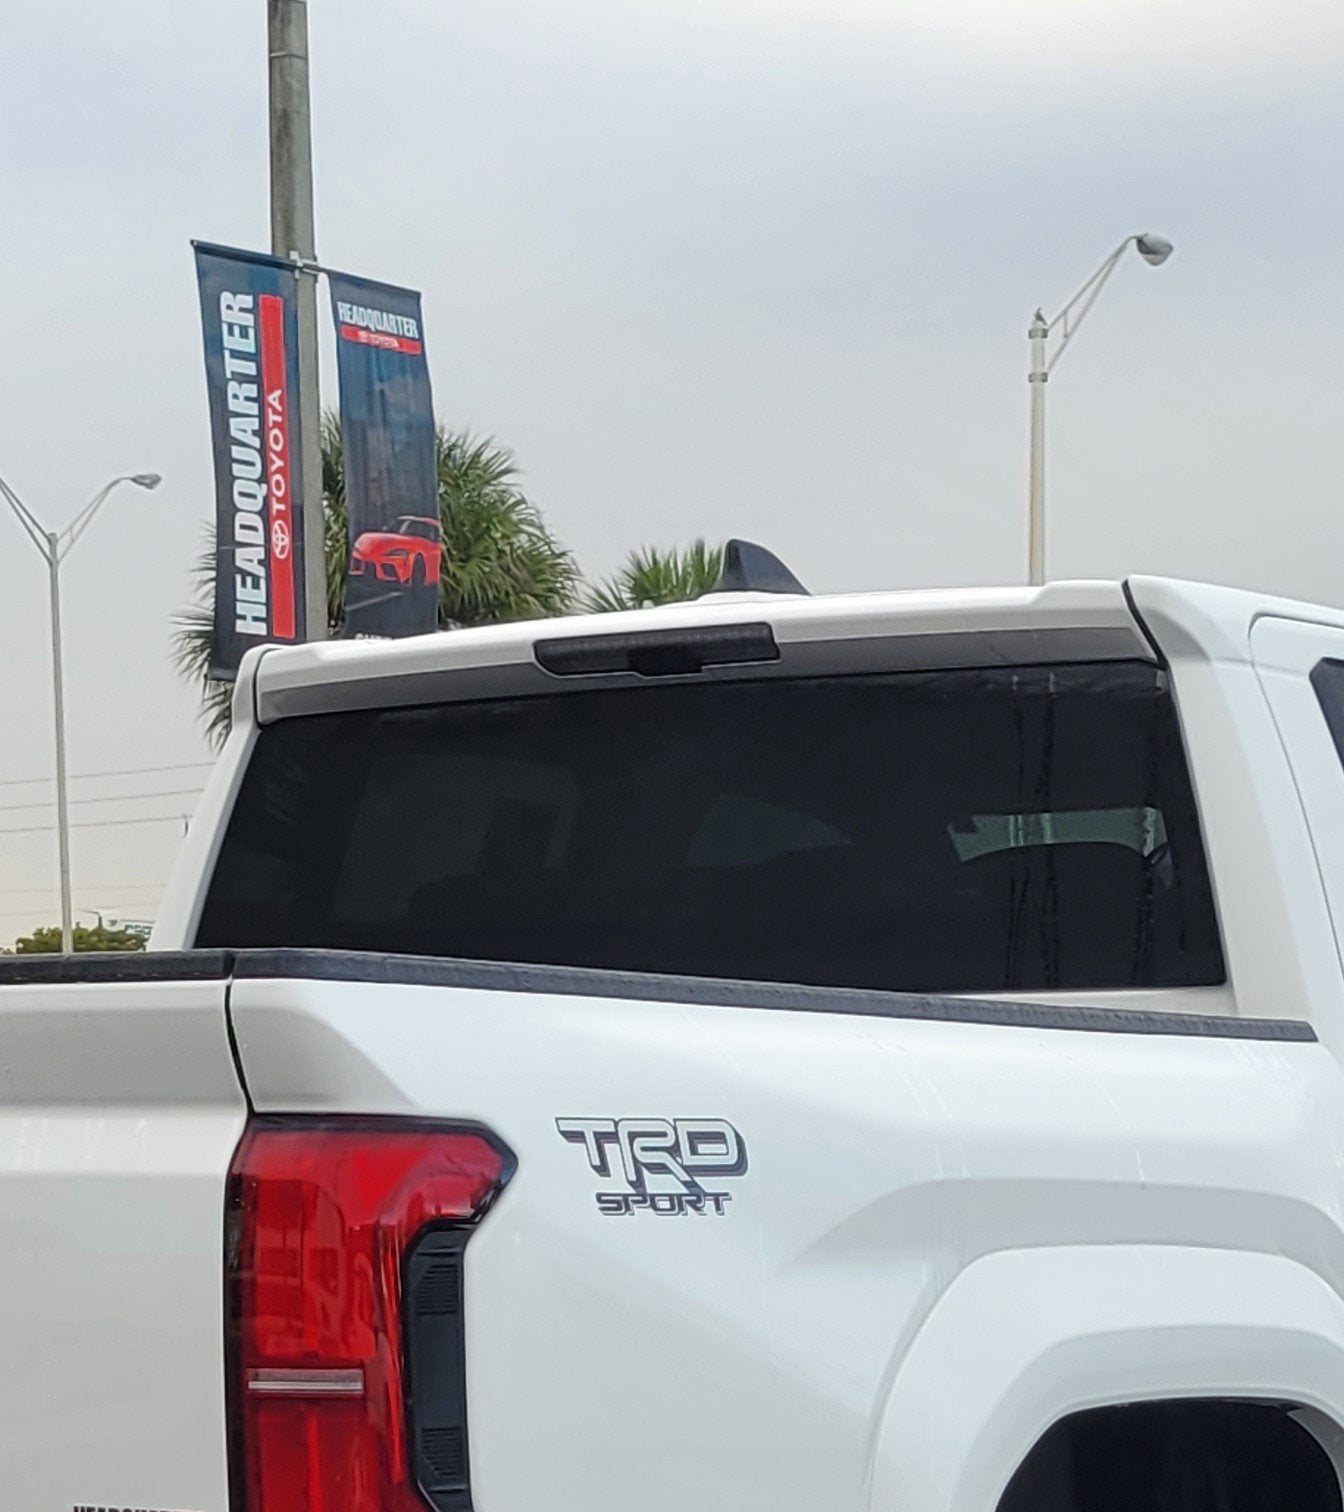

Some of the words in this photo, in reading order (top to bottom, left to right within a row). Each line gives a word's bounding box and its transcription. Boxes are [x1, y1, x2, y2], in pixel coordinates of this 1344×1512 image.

[335, 300, 420, 339] HEADQUARTER
[219, 290, 268, 636] HEADQUARTER
[269, 388, 288, 516] TOYOTA
[555, 1117, 749, 1192] TRD
[596, 1191, 733, 1216] SPORT
